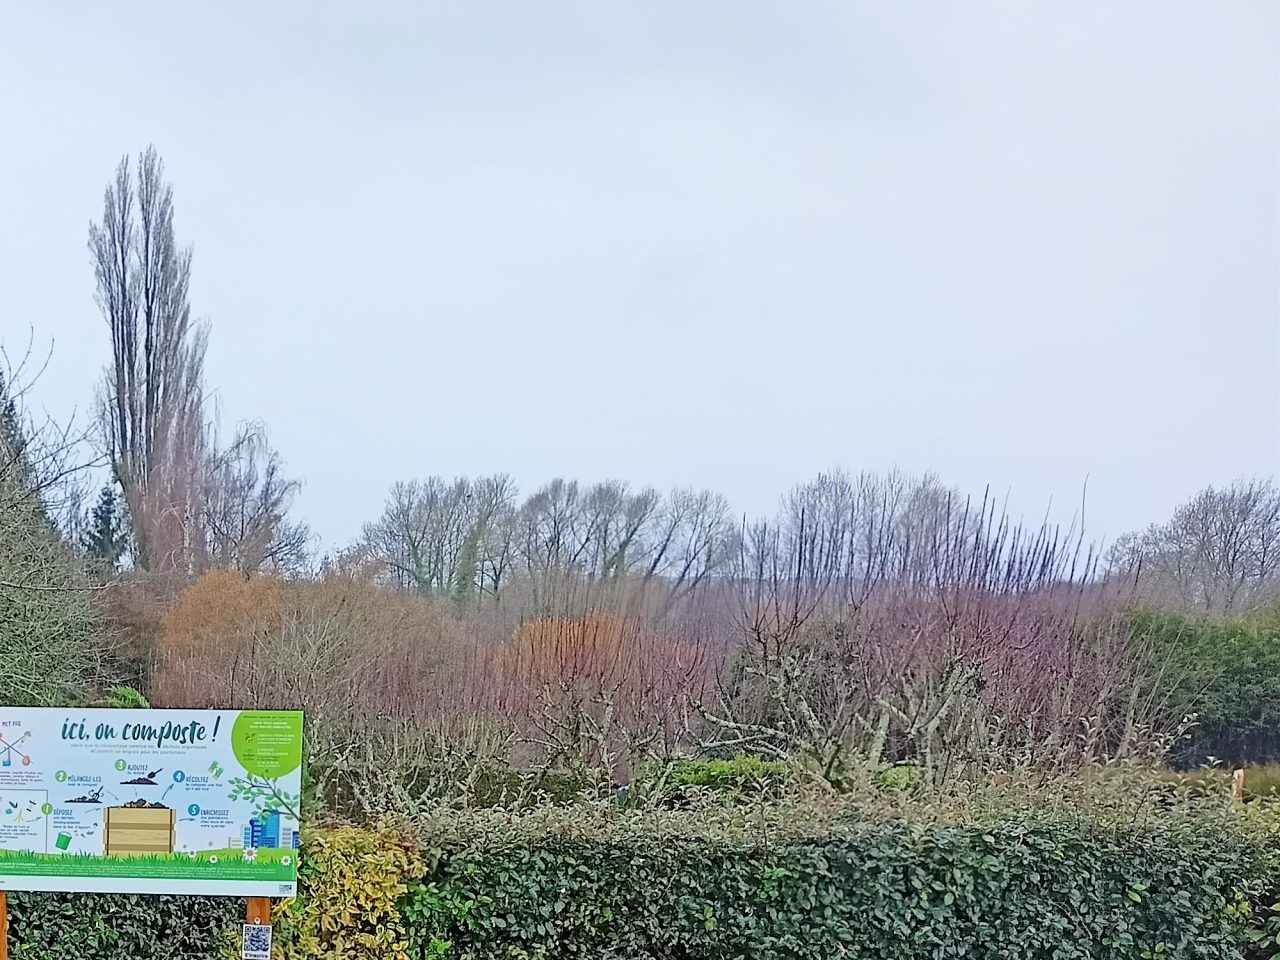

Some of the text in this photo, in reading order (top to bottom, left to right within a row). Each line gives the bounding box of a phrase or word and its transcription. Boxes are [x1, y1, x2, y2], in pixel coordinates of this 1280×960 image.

[61, 715, 221, 749] ici, on composte !
[118, 761, 124, 770] 3
[58, 771, 64, 781] 2
[186, 775, 209, 783] RÉCOLTEZ
[53, 808, 73, 816] DÉPOSEZ
[191, 805, 197, 815] 5
